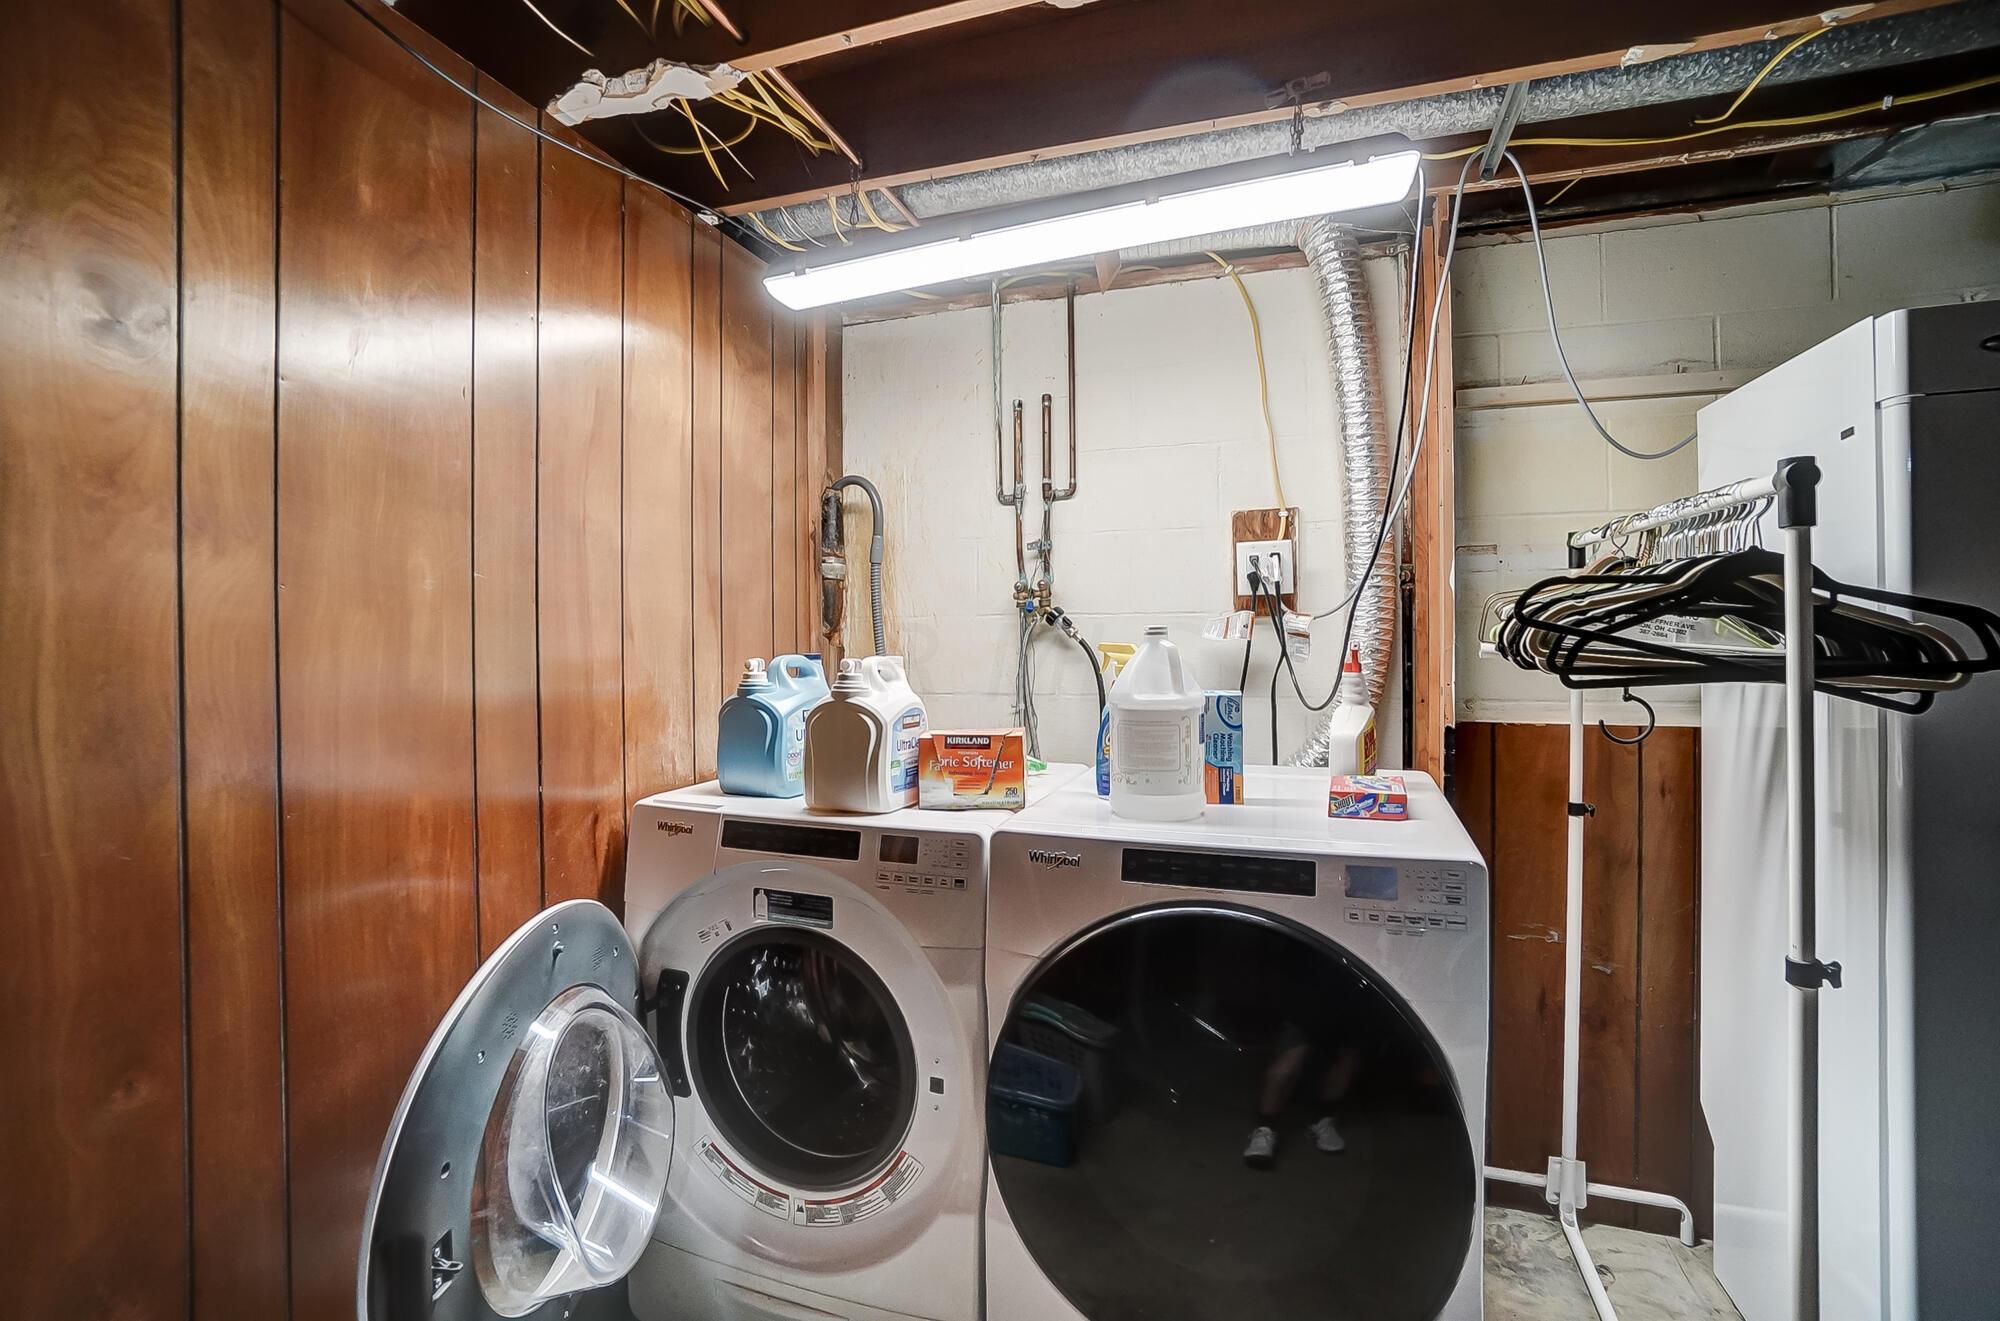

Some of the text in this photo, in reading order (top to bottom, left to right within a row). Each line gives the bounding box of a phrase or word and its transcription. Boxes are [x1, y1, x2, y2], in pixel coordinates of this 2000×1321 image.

[946, 737, 990, 745] KIRKLAND
[1226, 733, 1234, 762] Washing
[962, 755, 1015, 770] Softener
[1333, 794, 1355, 811] SHOUT
[657, 820, 694, 837] Whirlpool
[1028, 849, 1081, 870] Whirlpool
